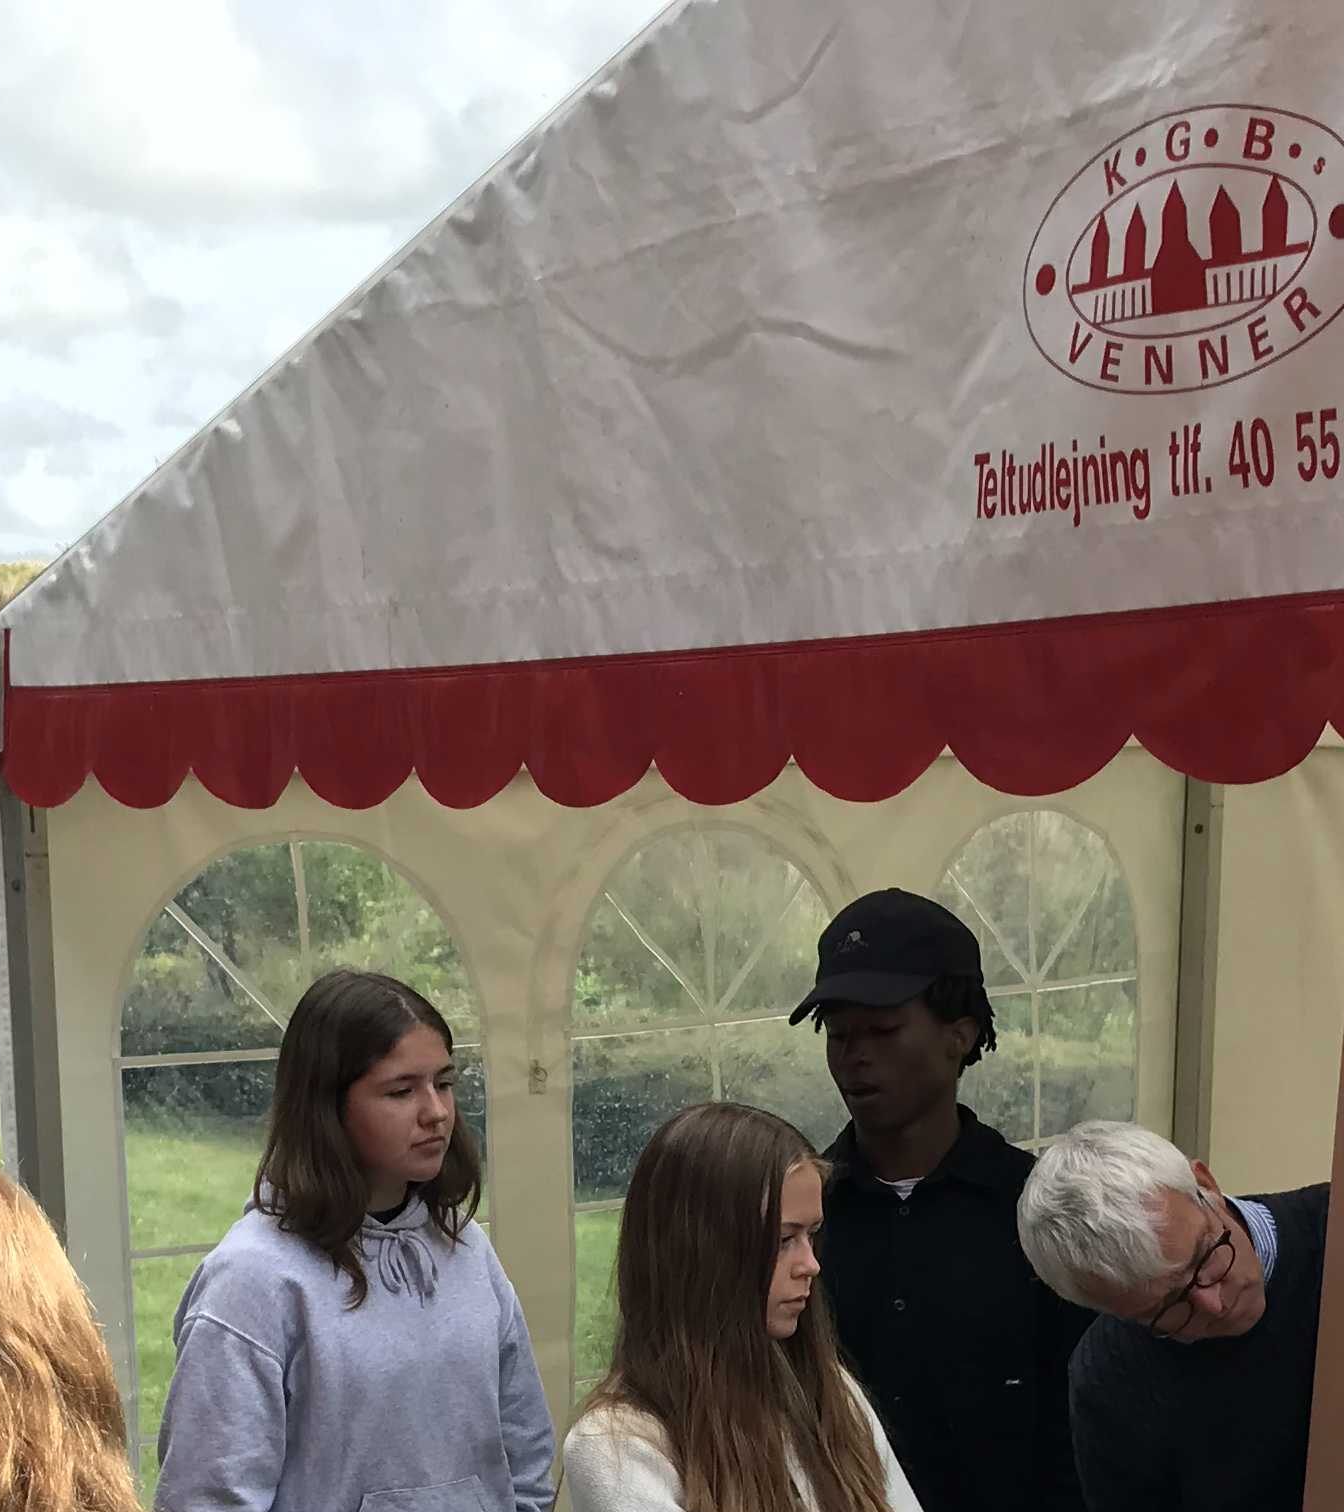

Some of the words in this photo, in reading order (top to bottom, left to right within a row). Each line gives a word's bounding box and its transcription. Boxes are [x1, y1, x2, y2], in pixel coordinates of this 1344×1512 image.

[1067, 286, 1323, 386] VENNER
[973, 435, 1152, 529] Teltudlejning
[1168, 423, 1213, 498] tlf.
[1226, 417, 1276, 489] 40
[1295, 407, 1342, 482] 55
